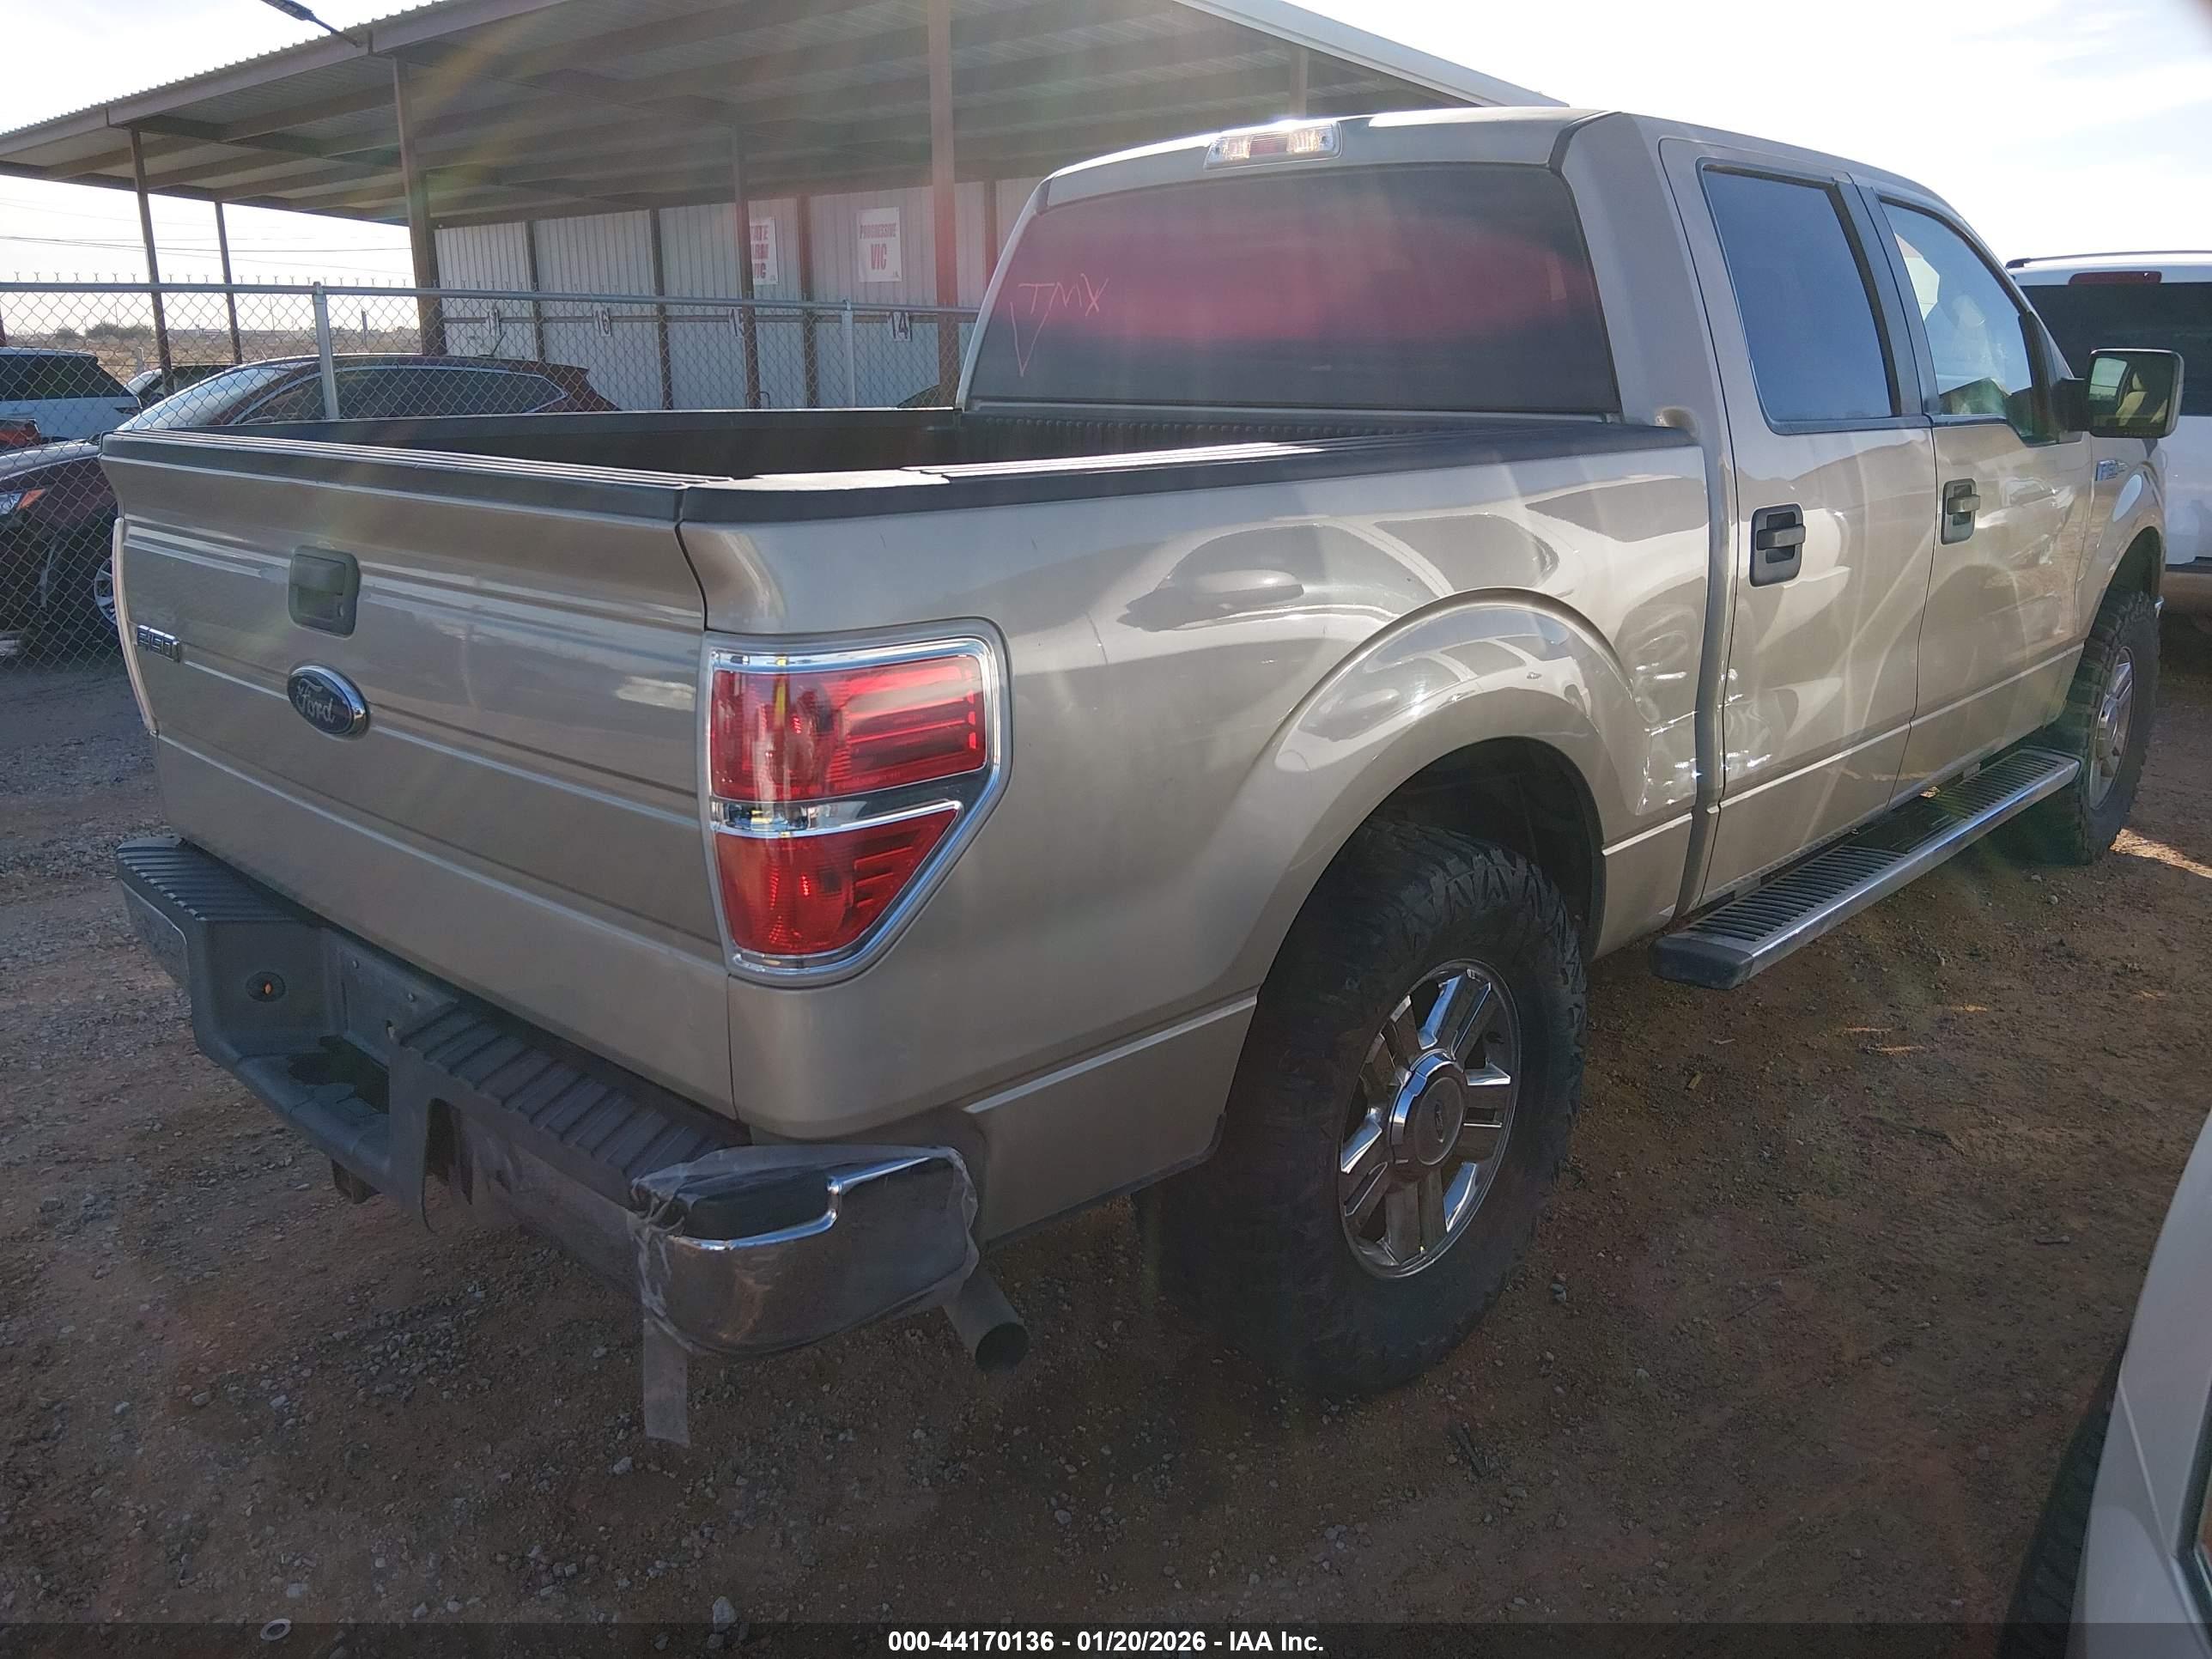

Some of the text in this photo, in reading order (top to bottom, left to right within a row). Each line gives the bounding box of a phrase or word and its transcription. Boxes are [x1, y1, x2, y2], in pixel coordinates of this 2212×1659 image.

[860, 223, 896, 240] PROGRESSIVE
[871, 243, 887, 270] VIC
[1018, 272, 1110, 317] TMX
[888, 311, 909, 340] 14
[295, 678, 336, 724] Ford
